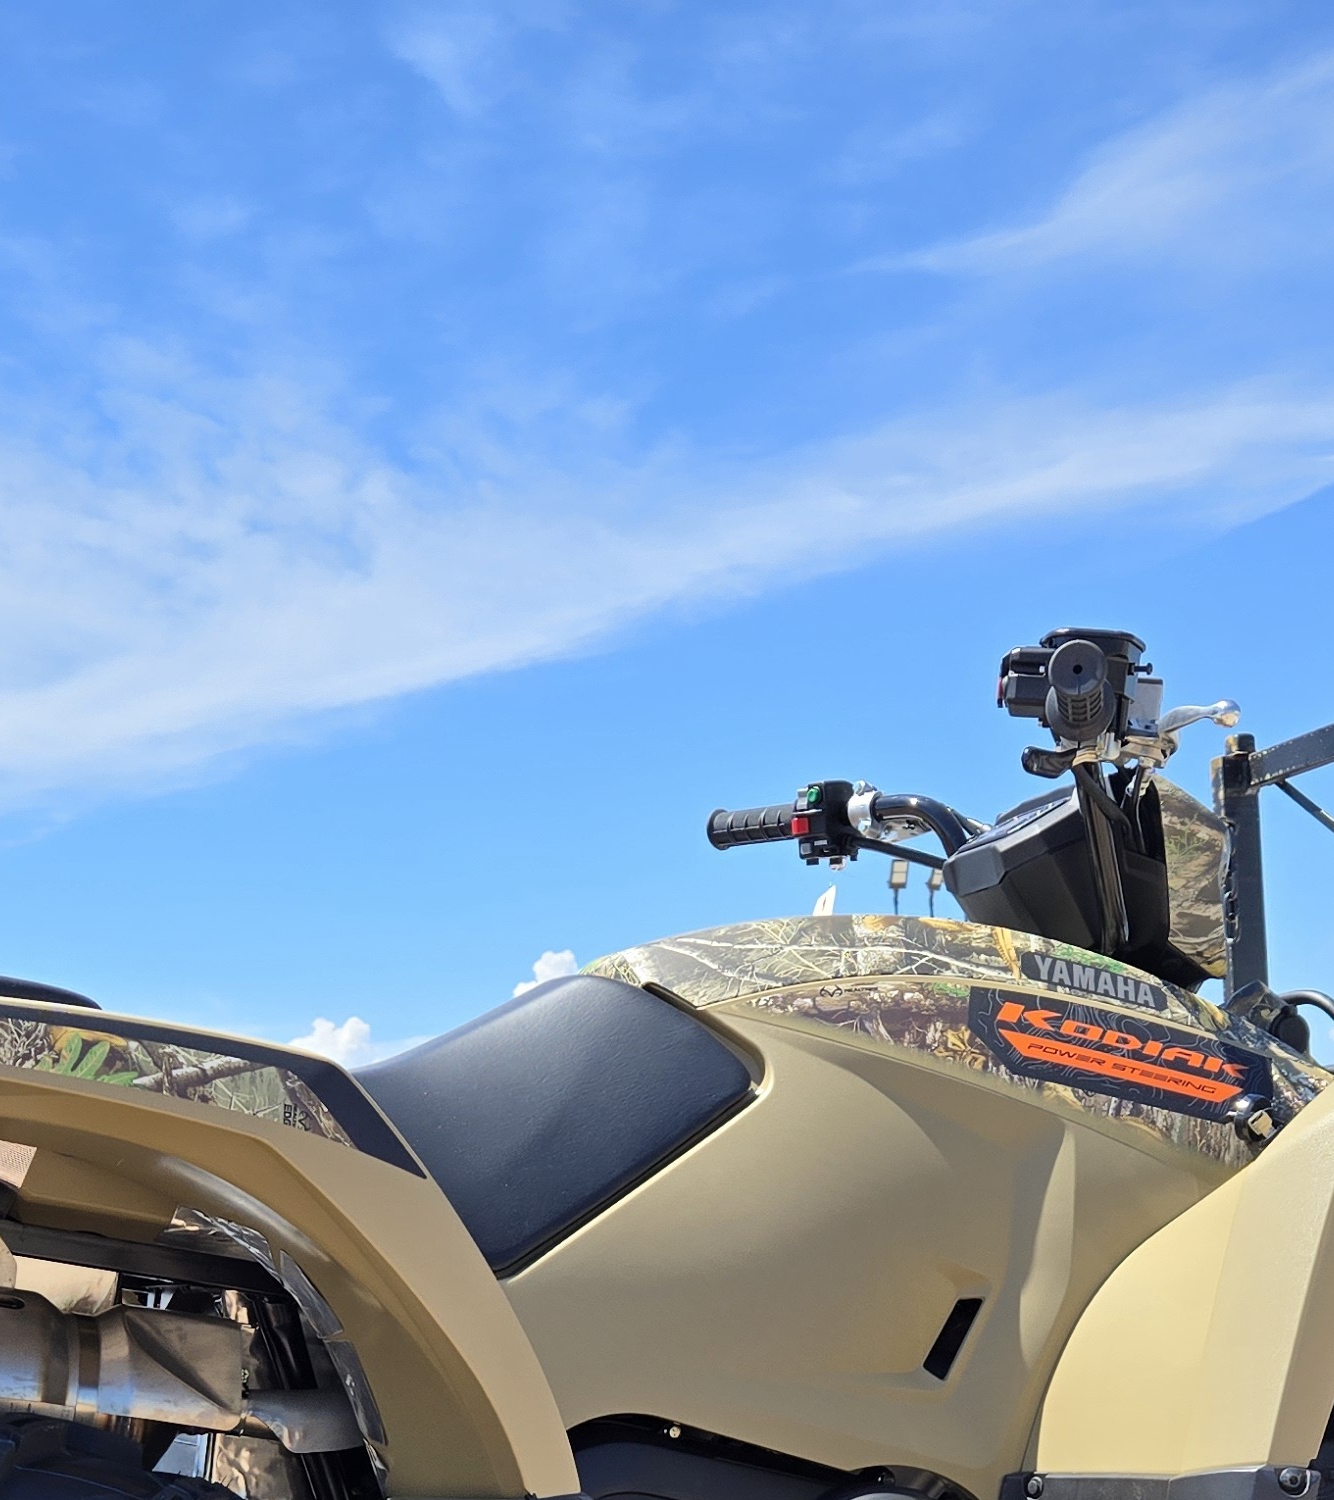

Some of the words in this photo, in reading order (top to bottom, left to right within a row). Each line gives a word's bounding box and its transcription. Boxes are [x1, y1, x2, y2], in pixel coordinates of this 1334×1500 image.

[1034, 953, 1157, 1008] YAMAHA
[996, 1001, 1250, 1080] KODIAK
[1027, 1041, 1107, 1067] POWER
[1112, 1062, 1218, 1095] STEERING
